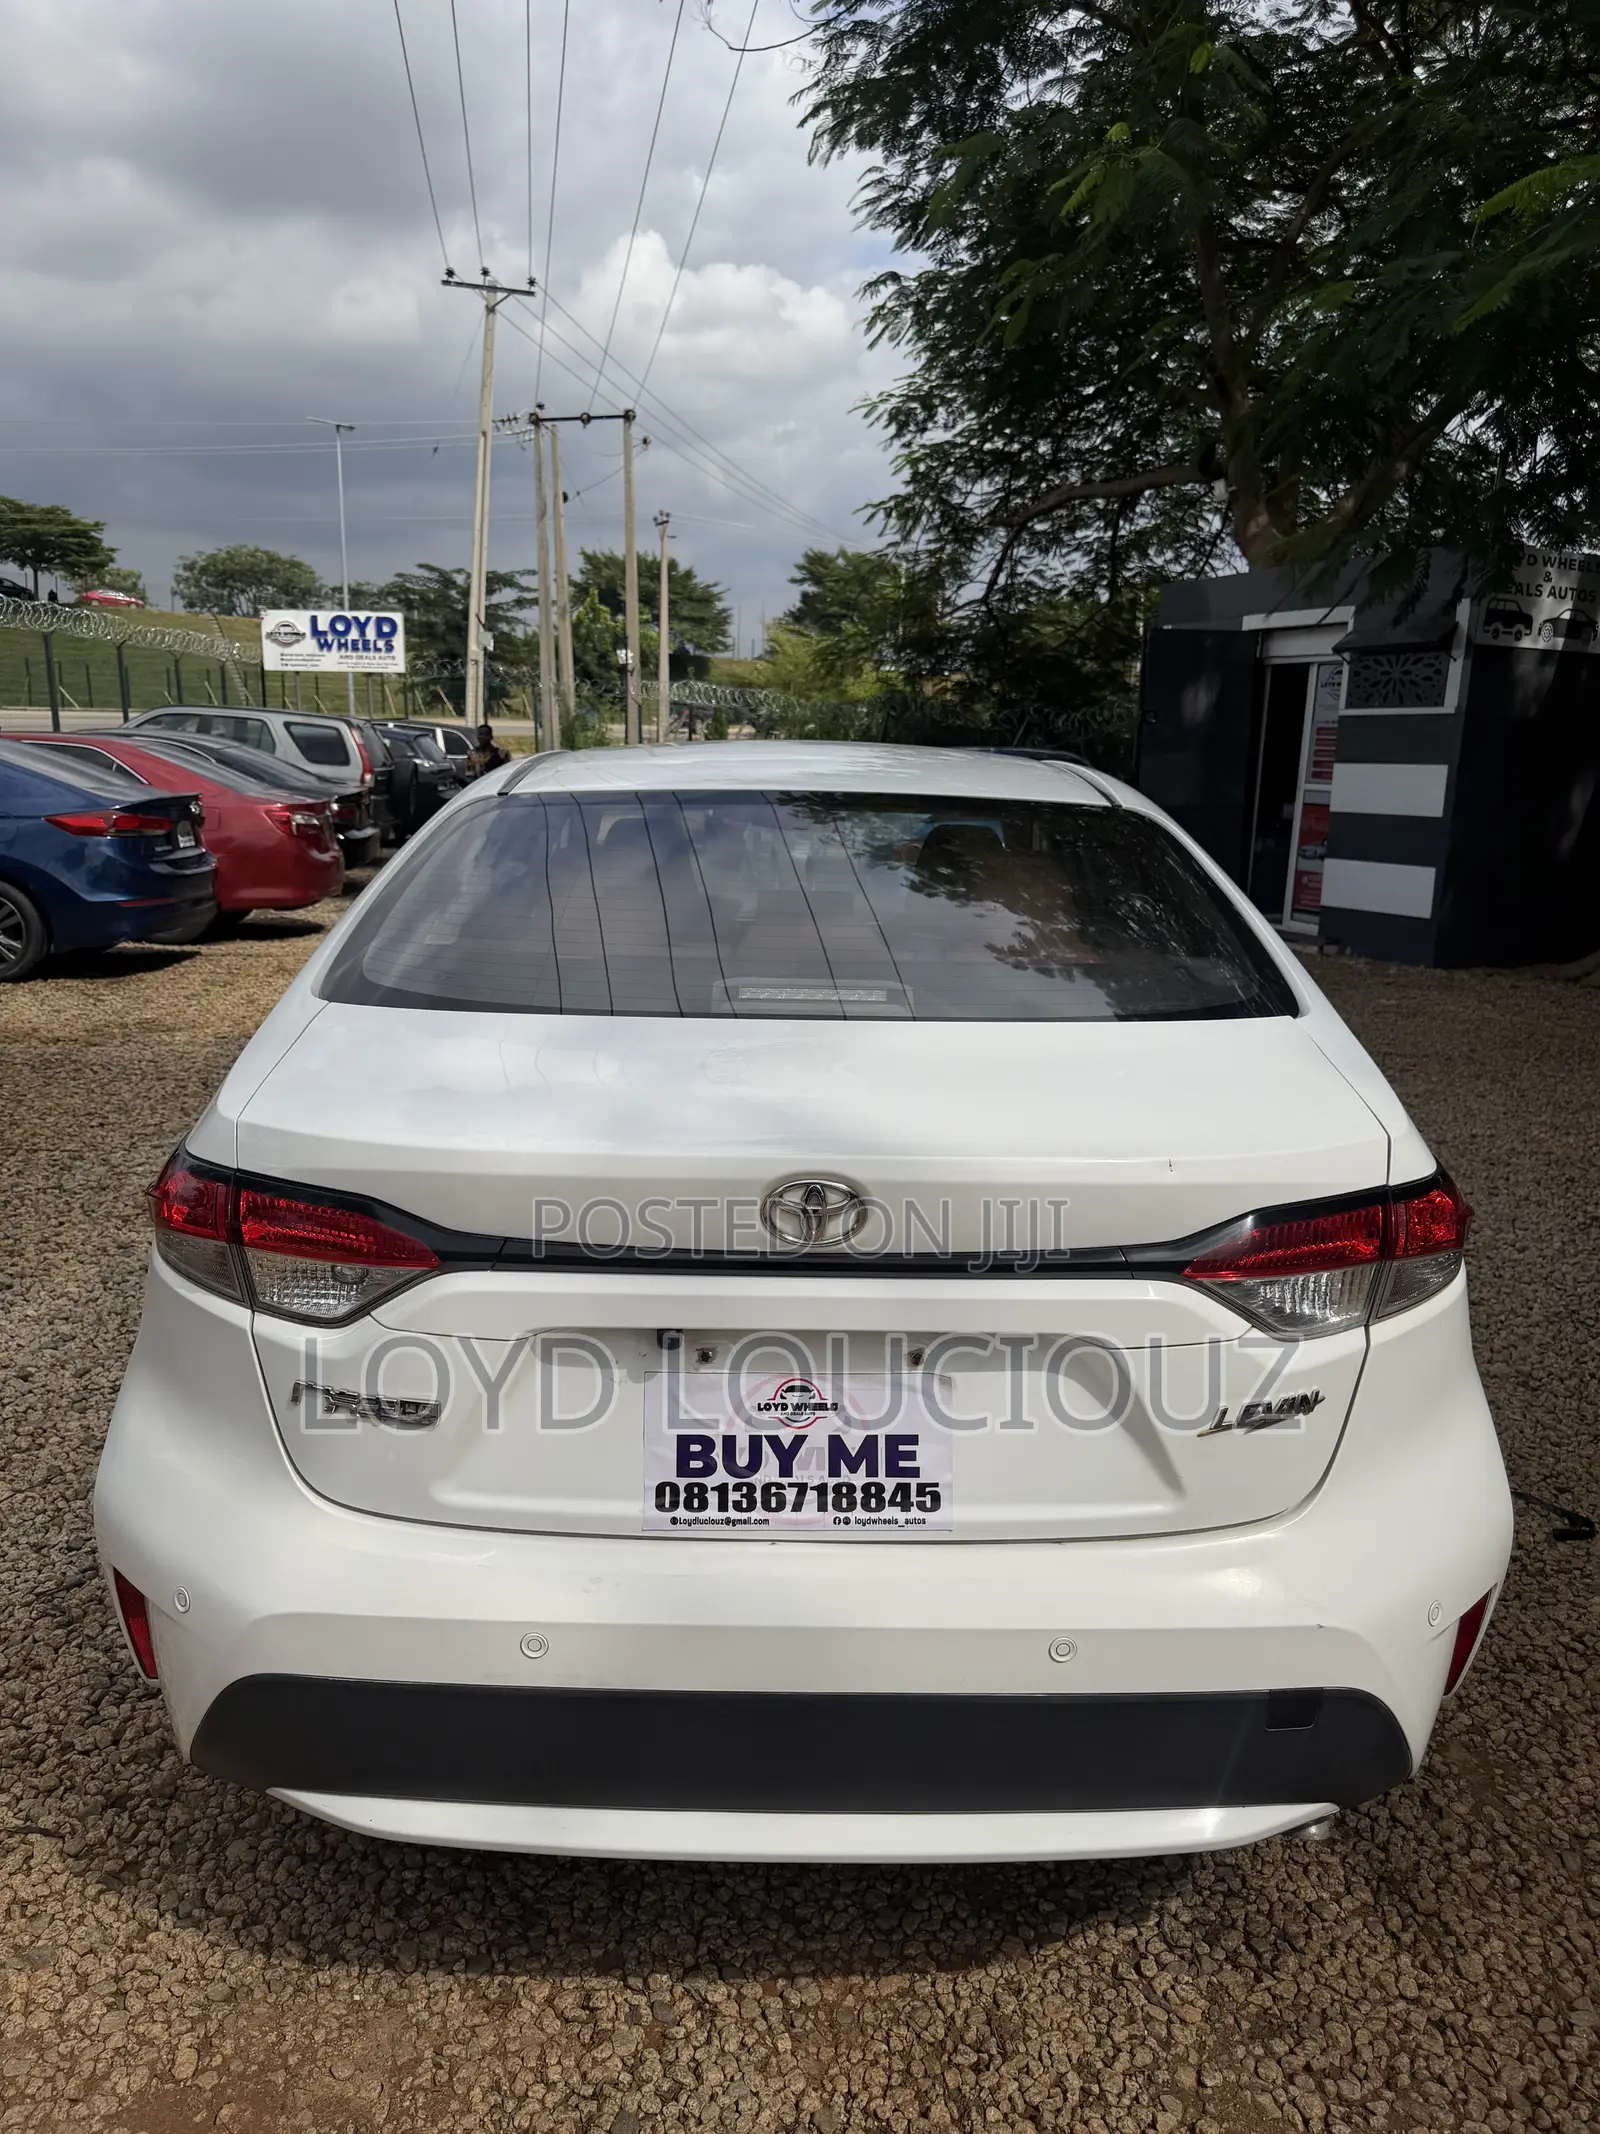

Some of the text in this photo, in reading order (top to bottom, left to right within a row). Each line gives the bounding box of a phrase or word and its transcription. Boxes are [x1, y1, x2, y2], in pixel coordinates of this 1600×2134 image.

[1543, 571, 1553, 582] &
[1547, 585, 1597, 604] AUTOS
[310, 615, 398, 639] LOYD
[317, 638, 394, 652] WHEELS
[757, 1402, 838, 1411] LOYD WHEELS
[676, 1434, 920, 1479] BUY ME
[654, 1481, 942, 1513] 08136718845
[854, 1516, 927, 1527] loydwheels_autos
